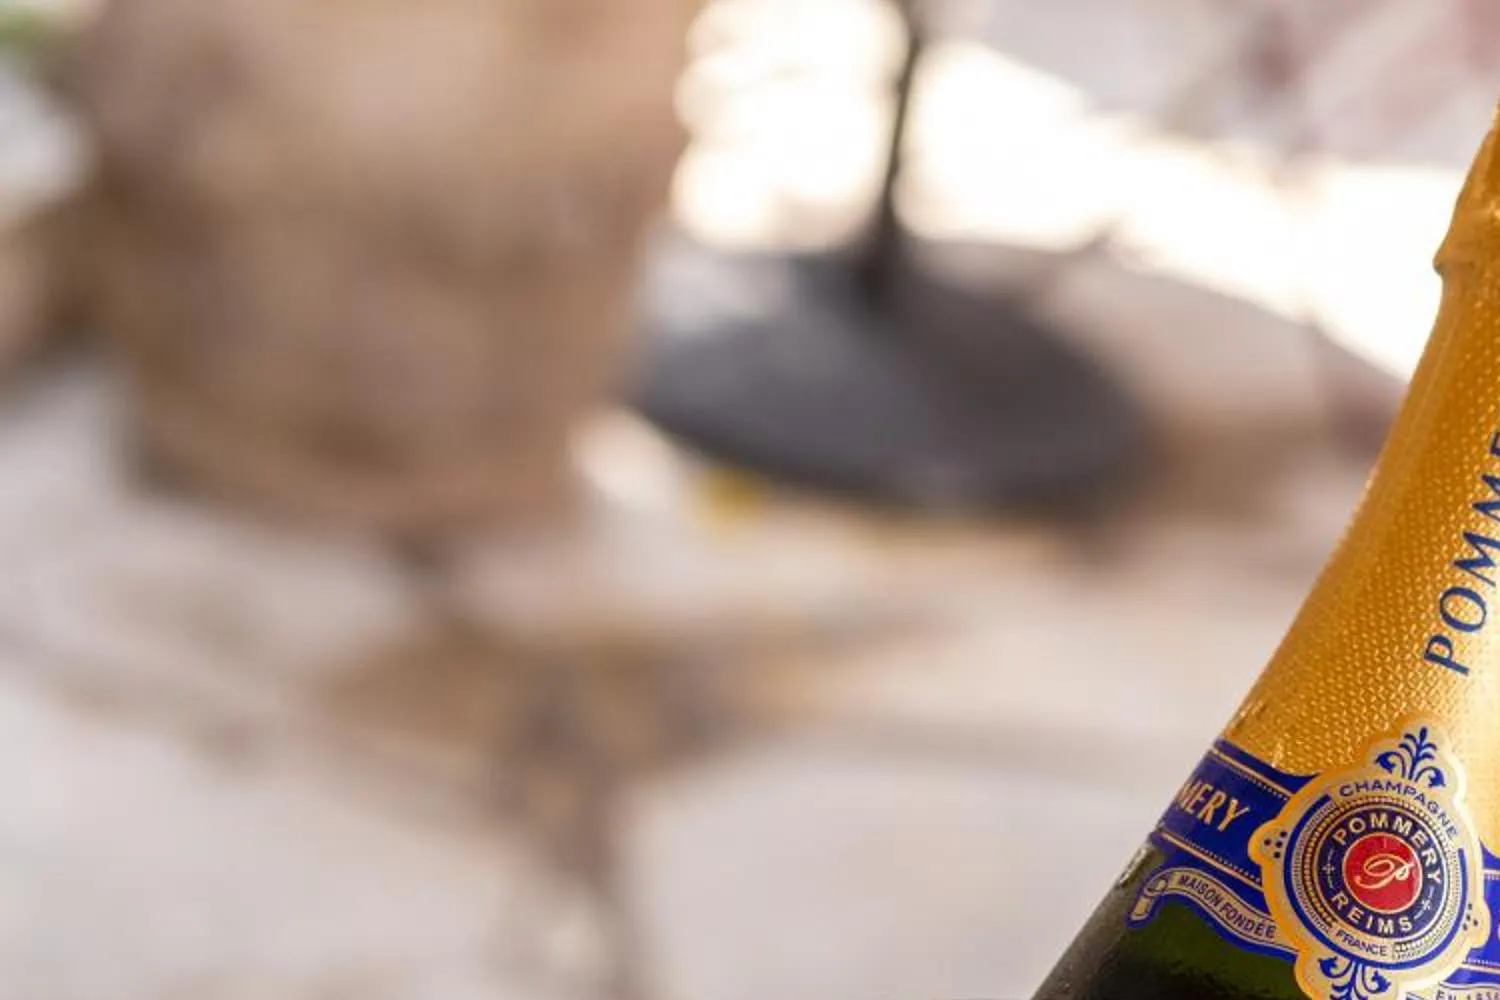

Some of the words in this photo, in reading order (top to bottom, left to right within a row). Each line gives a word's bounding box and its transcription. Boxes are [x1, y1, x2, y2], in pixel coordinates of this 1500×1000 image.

[1339, 780, 1457, 839] CHAMPAGNE
[1332, 812, 1441, 884] POMMERY
[1179, 874, 1222, 907] MAISON
[1220, 902, 1277, 939] FONDÉE
[1332, 892, 1412, 934] REIMS
[1336, 929, 1387, 956] FRANCE
